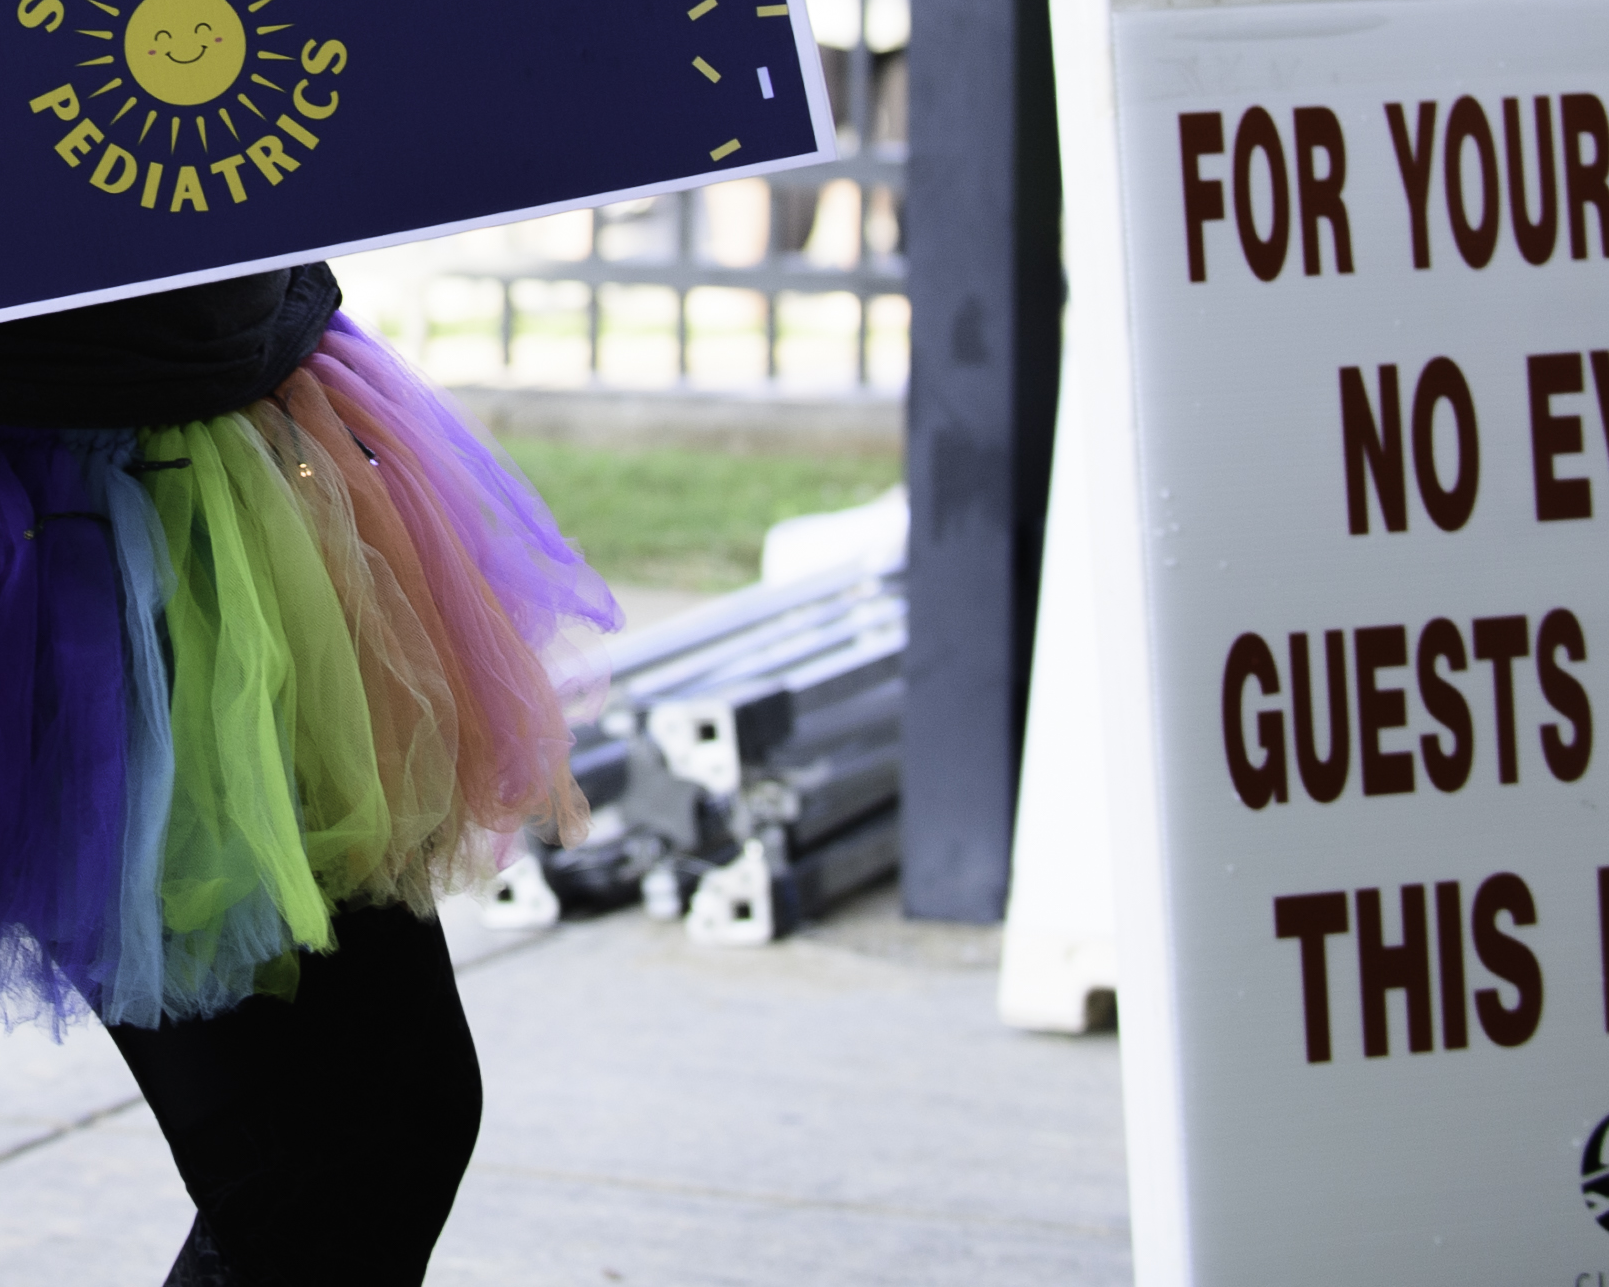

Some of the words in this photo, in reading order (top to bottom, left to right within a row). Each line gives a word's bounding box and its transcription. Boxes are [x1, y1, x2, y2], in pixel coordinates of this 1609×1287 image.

[28, 37, 348, 213] PEDIATRICS
[1178, 105, 1355, 283] FOR
[1383, 93, 1609, 270] YOUR
[1339, 355, 1479, 537] NO
[1222, 608, 1593, 810] GUESTS
[1273, 871, 1543, 1064] THIS
